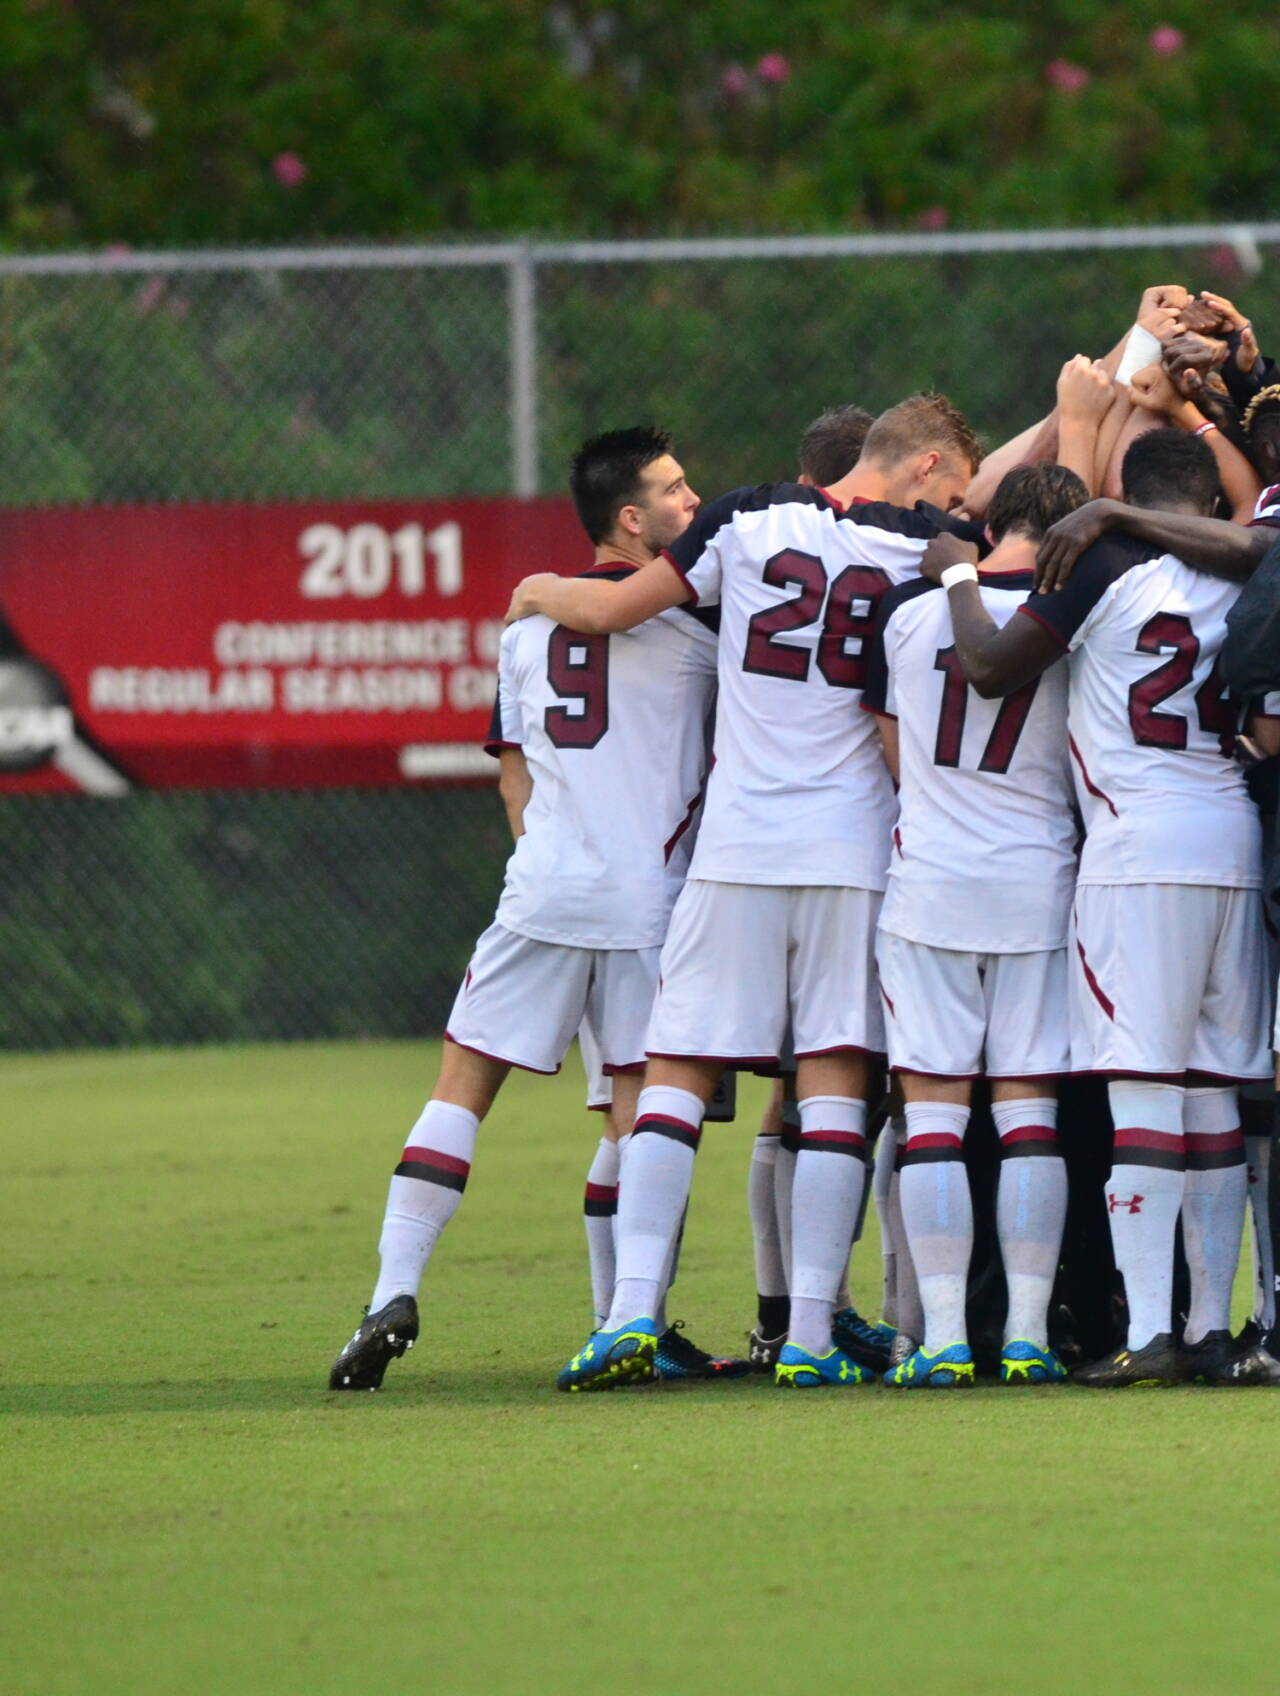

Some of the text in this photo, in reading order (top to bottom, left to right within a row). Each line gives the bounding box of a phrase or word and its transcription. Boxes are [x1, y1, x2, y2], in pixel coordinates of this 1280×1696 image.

[300, 522, 463, 599] 2011
[213, 620, 469, 666] CONFERENCE
[743, 547, 893, 689] 28
[89, 665, 274, 713] REGULAR
[283, 666, 442, 712] SEASON
[544, 626, 610, 749] 9
[934, 644, 1042, 774] 17
